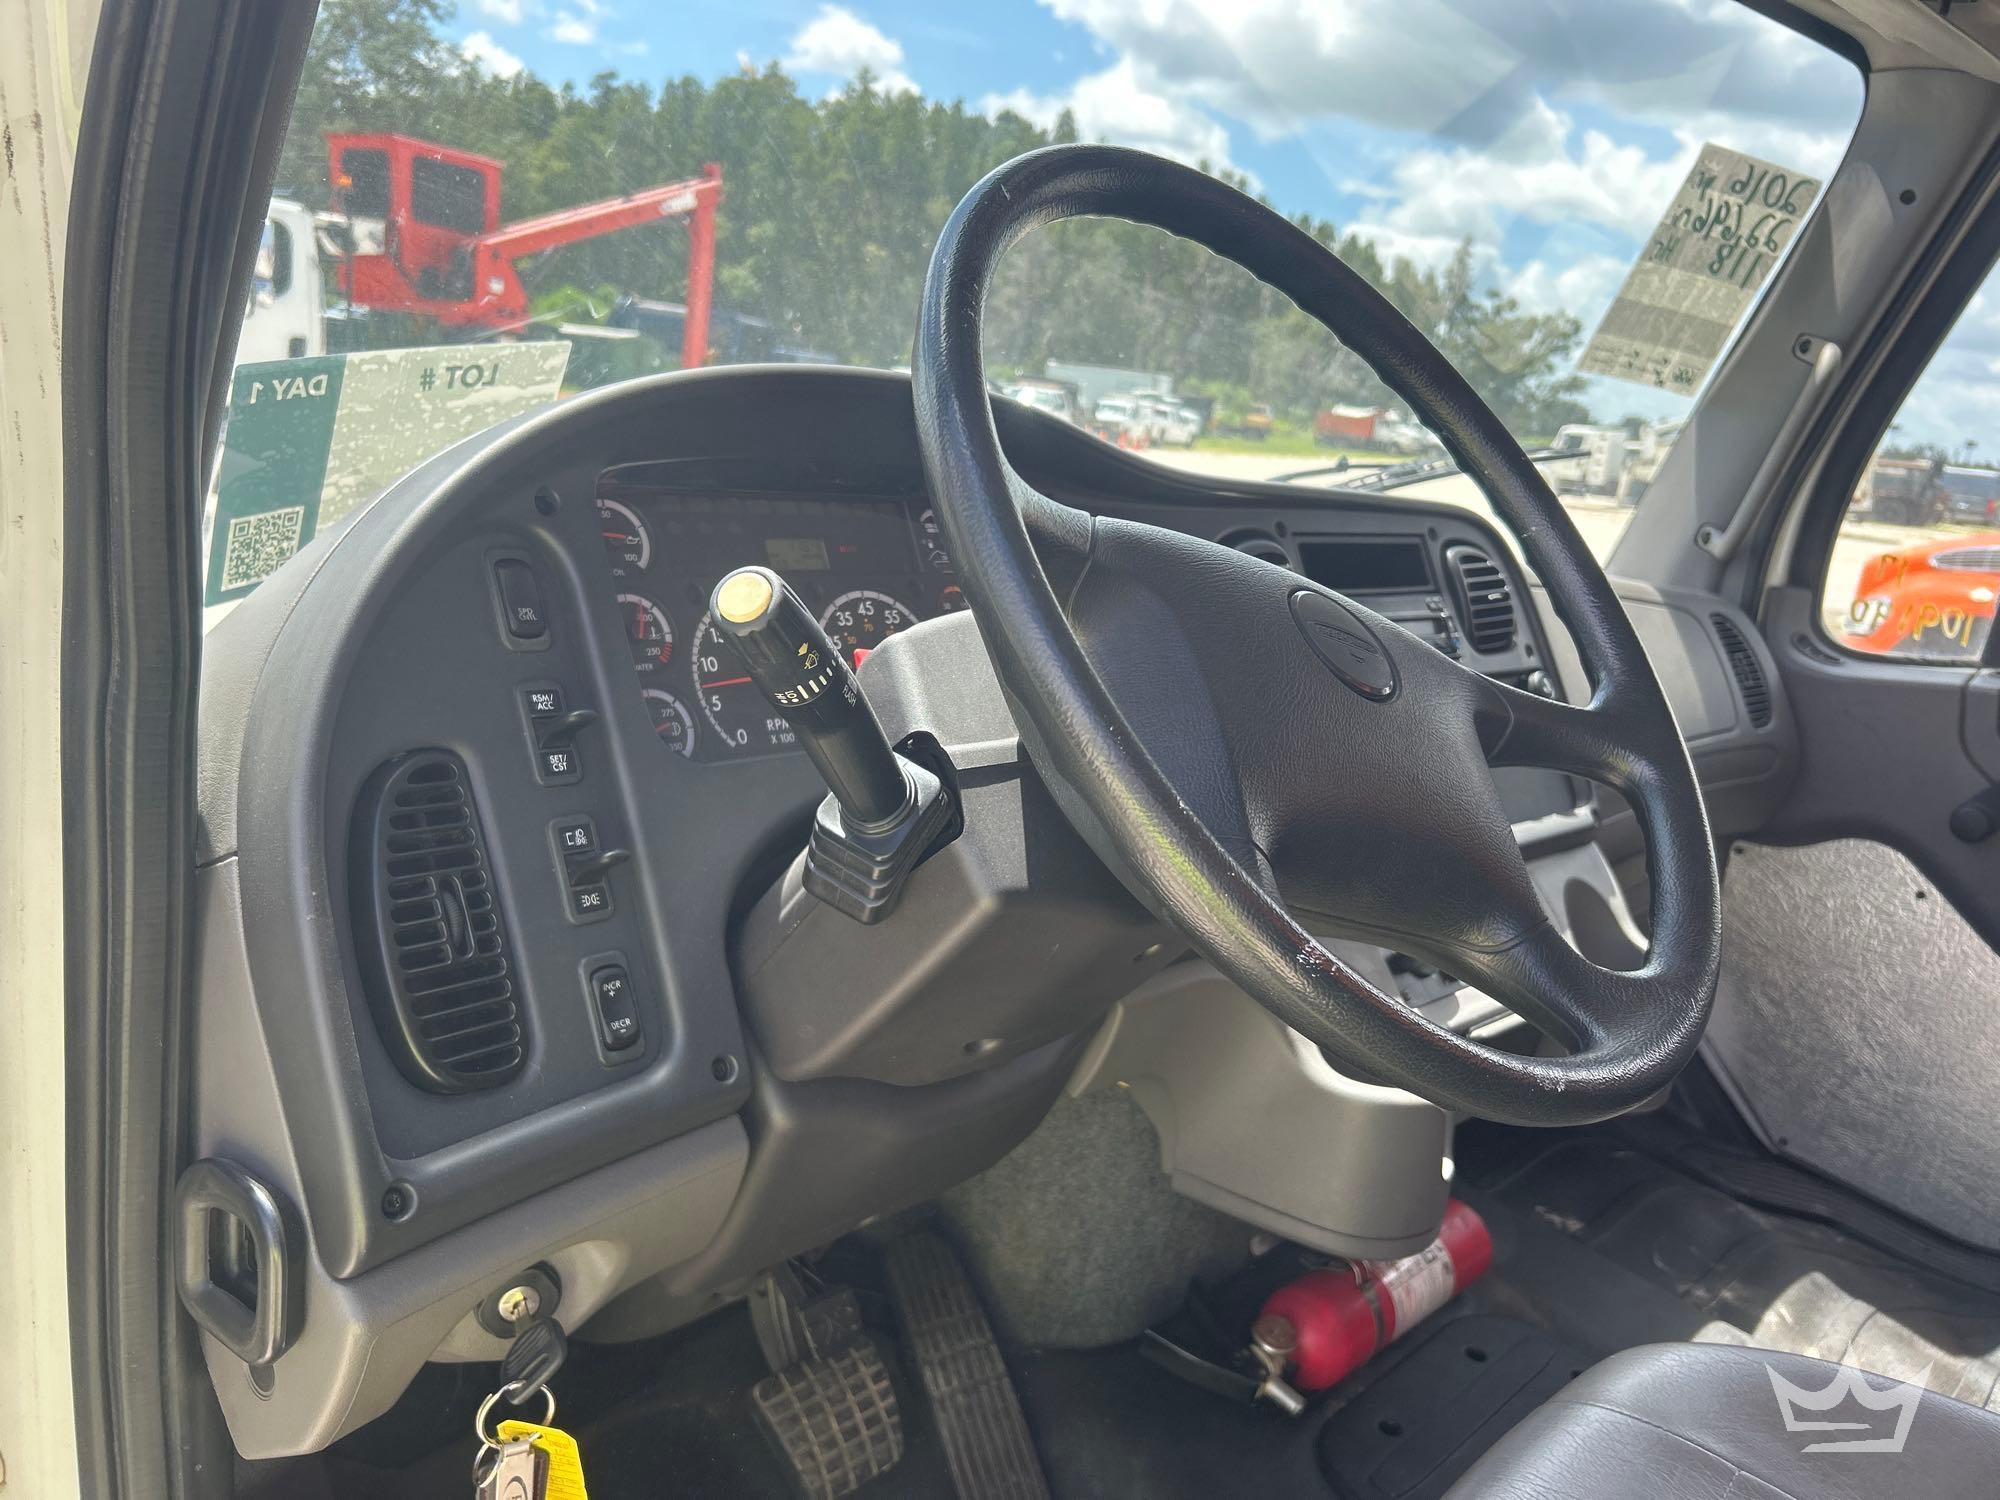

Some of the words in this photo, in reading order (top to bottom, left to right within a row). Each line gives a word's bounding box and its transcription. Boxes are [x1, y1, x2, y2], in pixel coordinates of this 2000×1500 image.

[624, 553, 638, 562] 100
[858, 601, 875, 616] 45
[836, 611, 854, 627] 35
[884, 610, 901, 625] 55
[709, 628, 724, 644] 1
[700, 656, 718, 672] 10
[532, 693, 554, 704] RSM/
[712, 695, 721, 711] 5
[537, 701, 555, 711] ACC
[737, 728, 748, 745] 0
[780, 732, 795, 743] 100
[549, 754, 567, 764] SET/
[552, 762, 568, 772] CST
[602, 979, 621, 992] INCR
[610, 1017, 631, 1030] DECR
